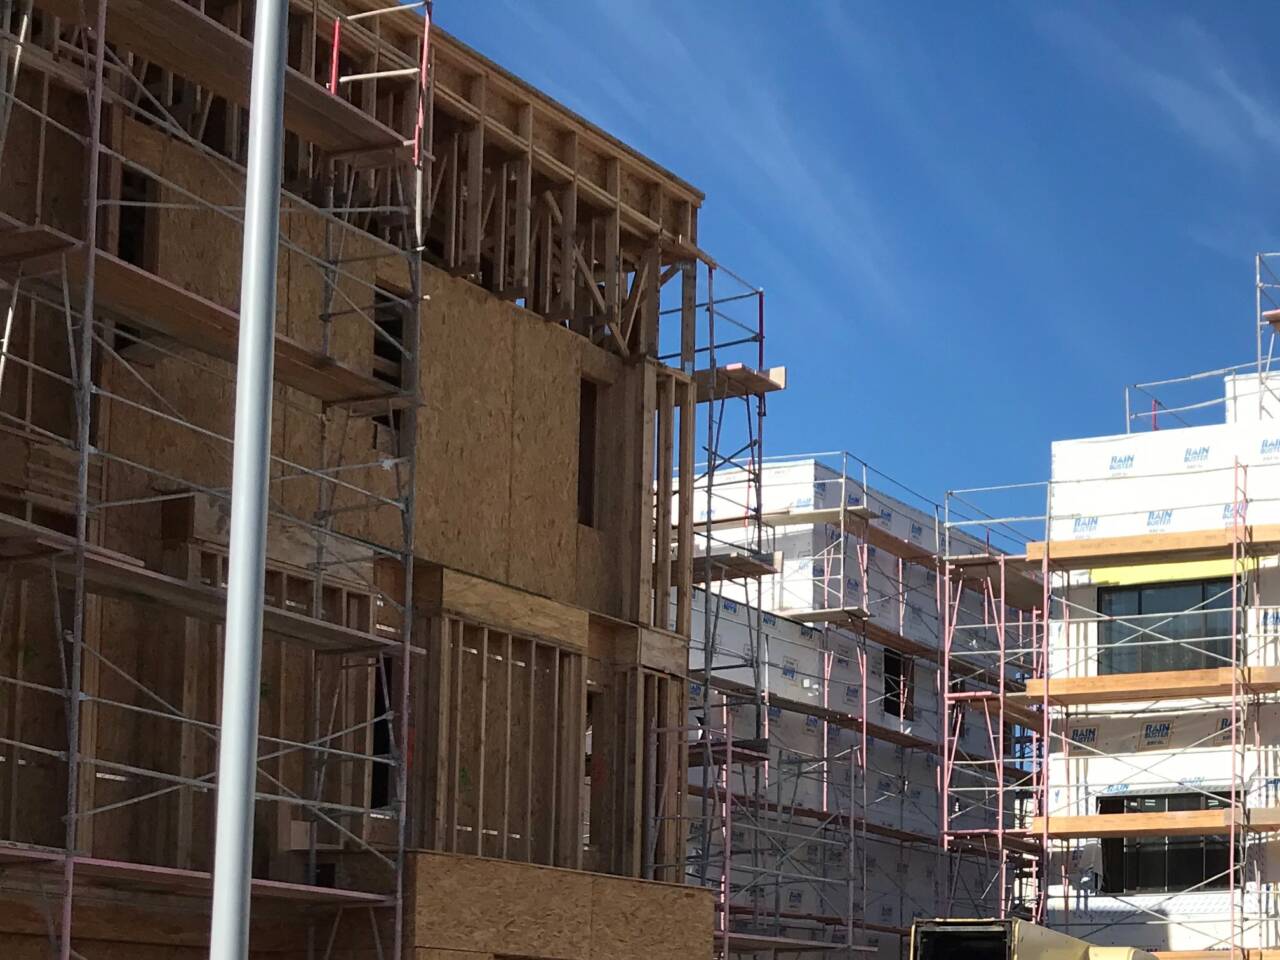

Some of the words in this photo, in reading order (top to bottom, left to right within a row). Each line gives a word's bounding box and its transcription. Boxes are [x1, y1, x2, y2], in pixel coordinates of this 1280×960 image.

[1185, 446, 1210, 457] RAIN
[1111, 454, 1134, 464] RAIN
[1148, 510, 1173, 520] RAIN
[1075, 517, 1098, 526] RAIN
[1072, 728, 1097, 737] RAIN
[1145, 723, 1170, 733] RAIN
